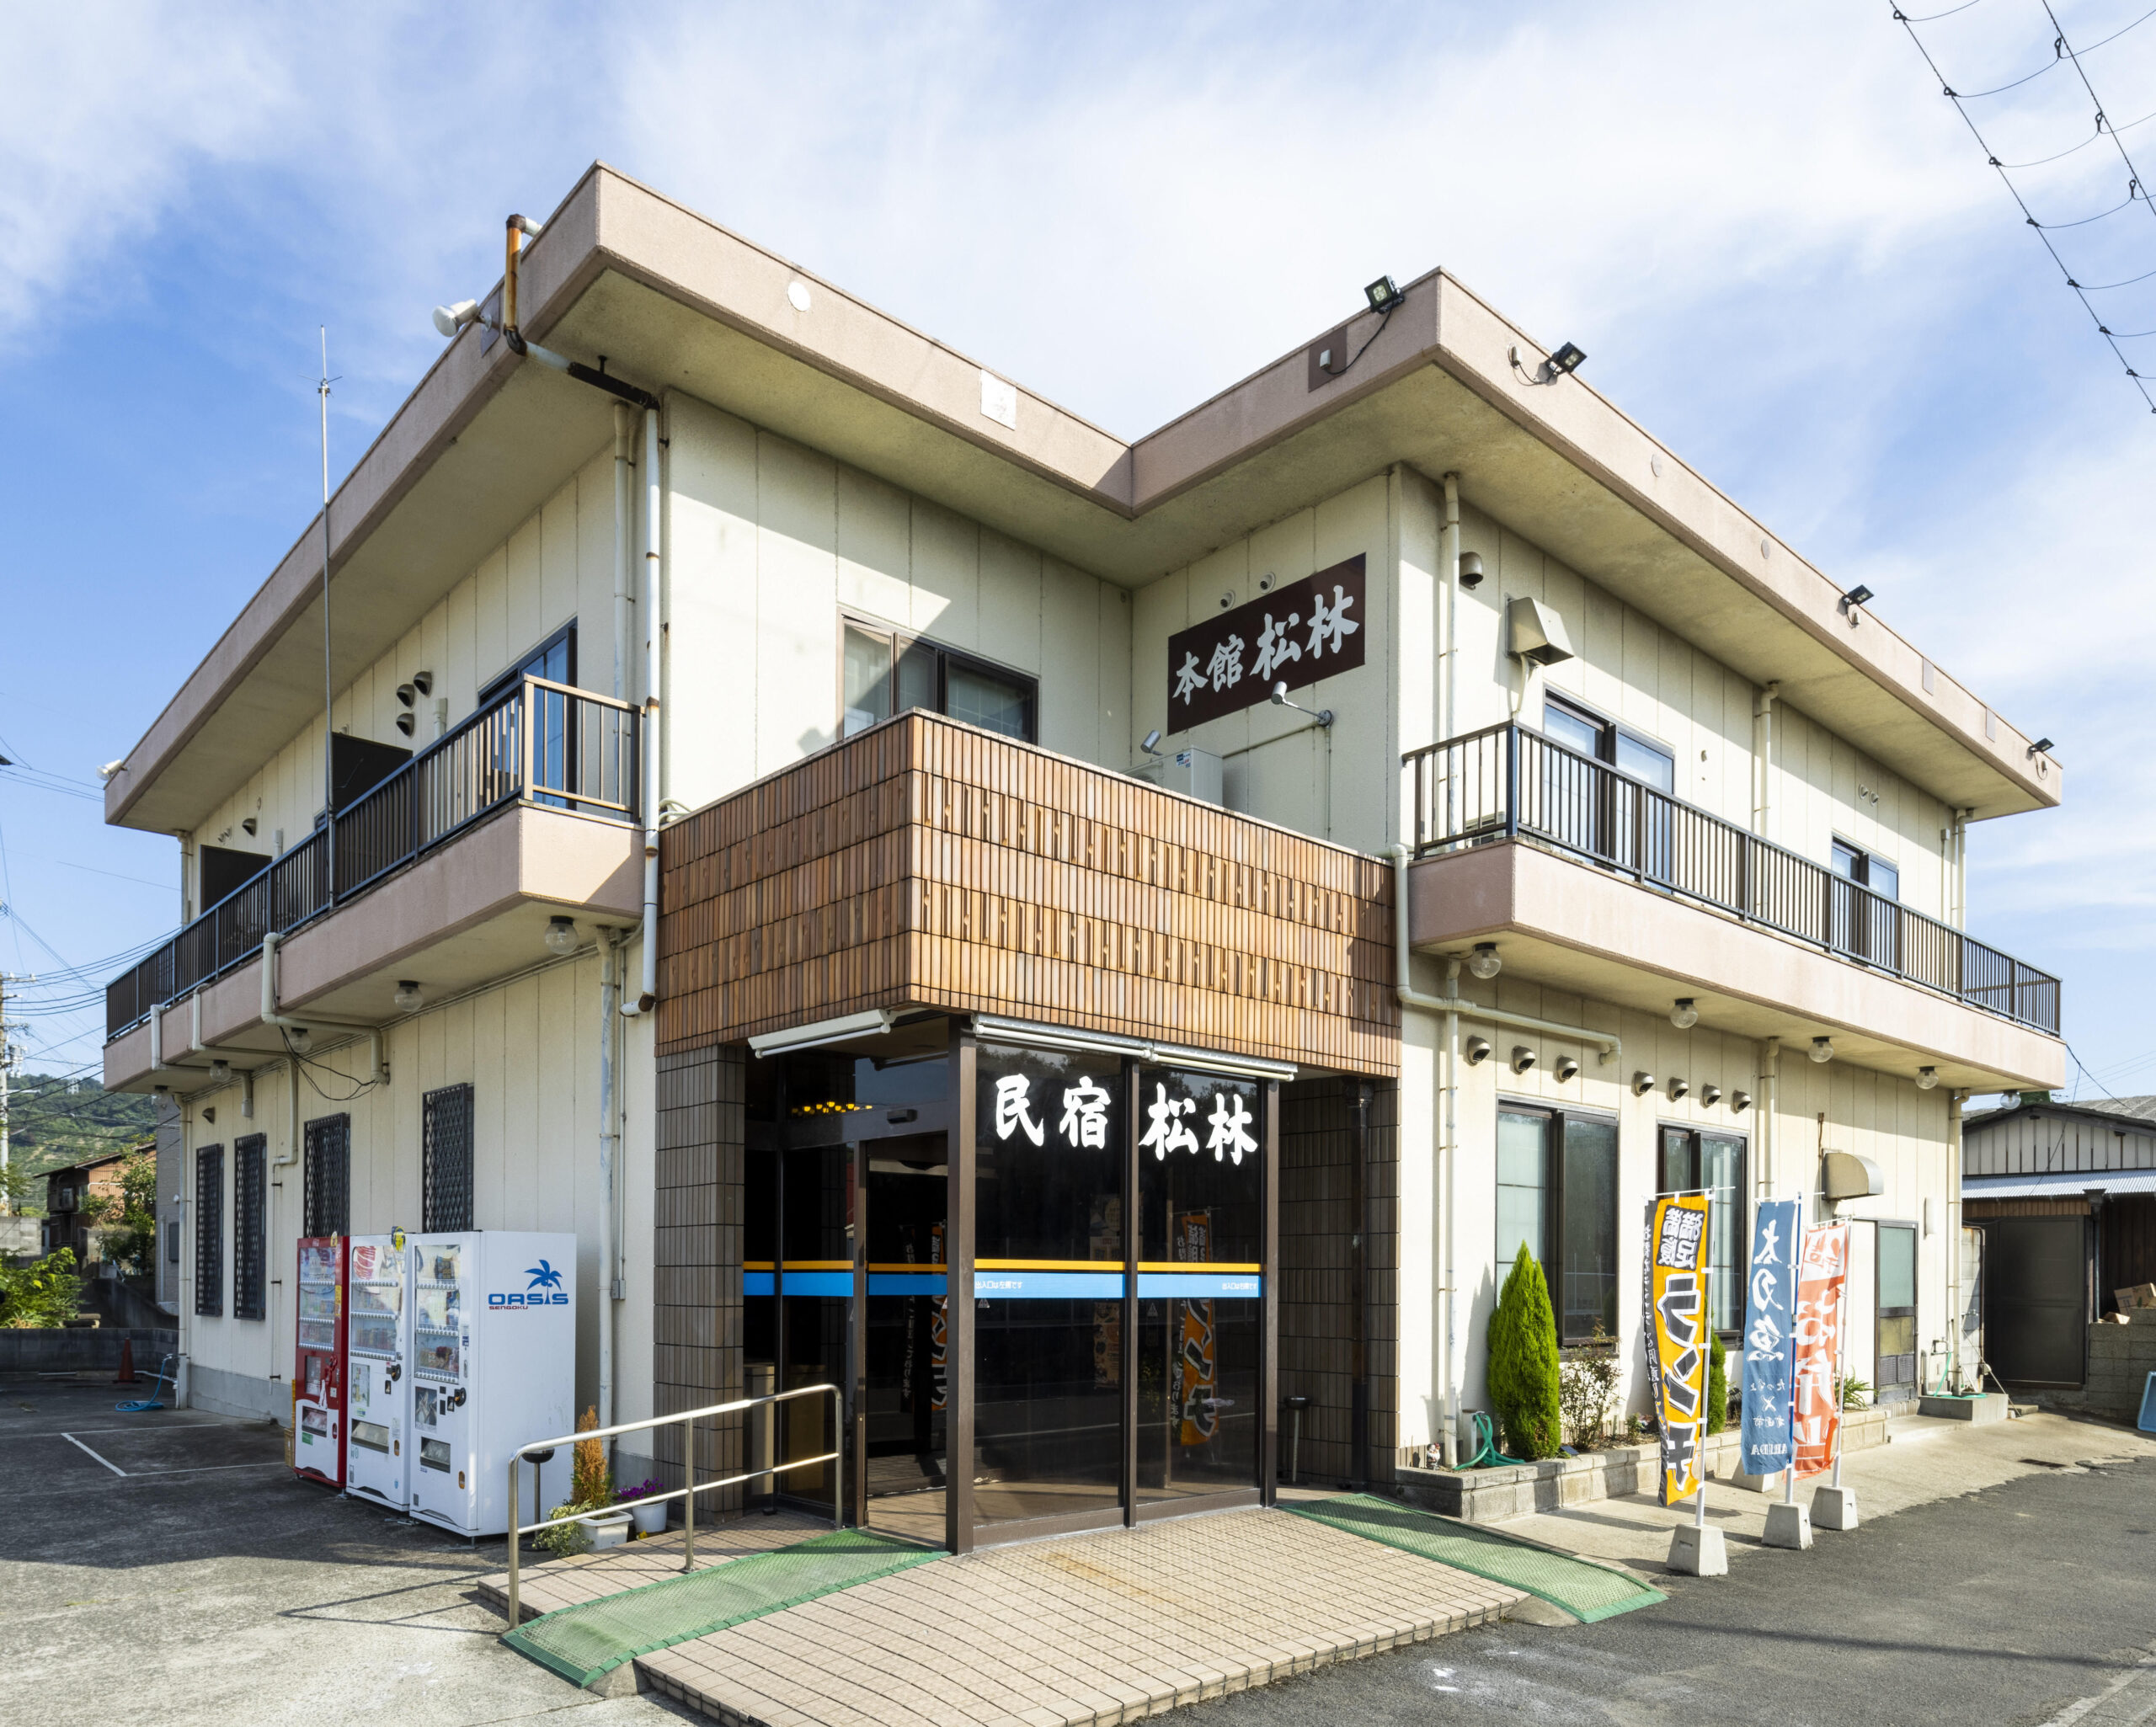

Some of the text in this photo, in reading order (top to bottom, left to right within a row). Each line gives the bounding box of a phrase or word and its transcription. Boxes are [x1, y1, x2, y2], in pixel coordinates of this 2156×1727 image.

[995, 1074, 1258, 1166] 民宿 松林
[488, 1293, 568, 1305] OASIS
